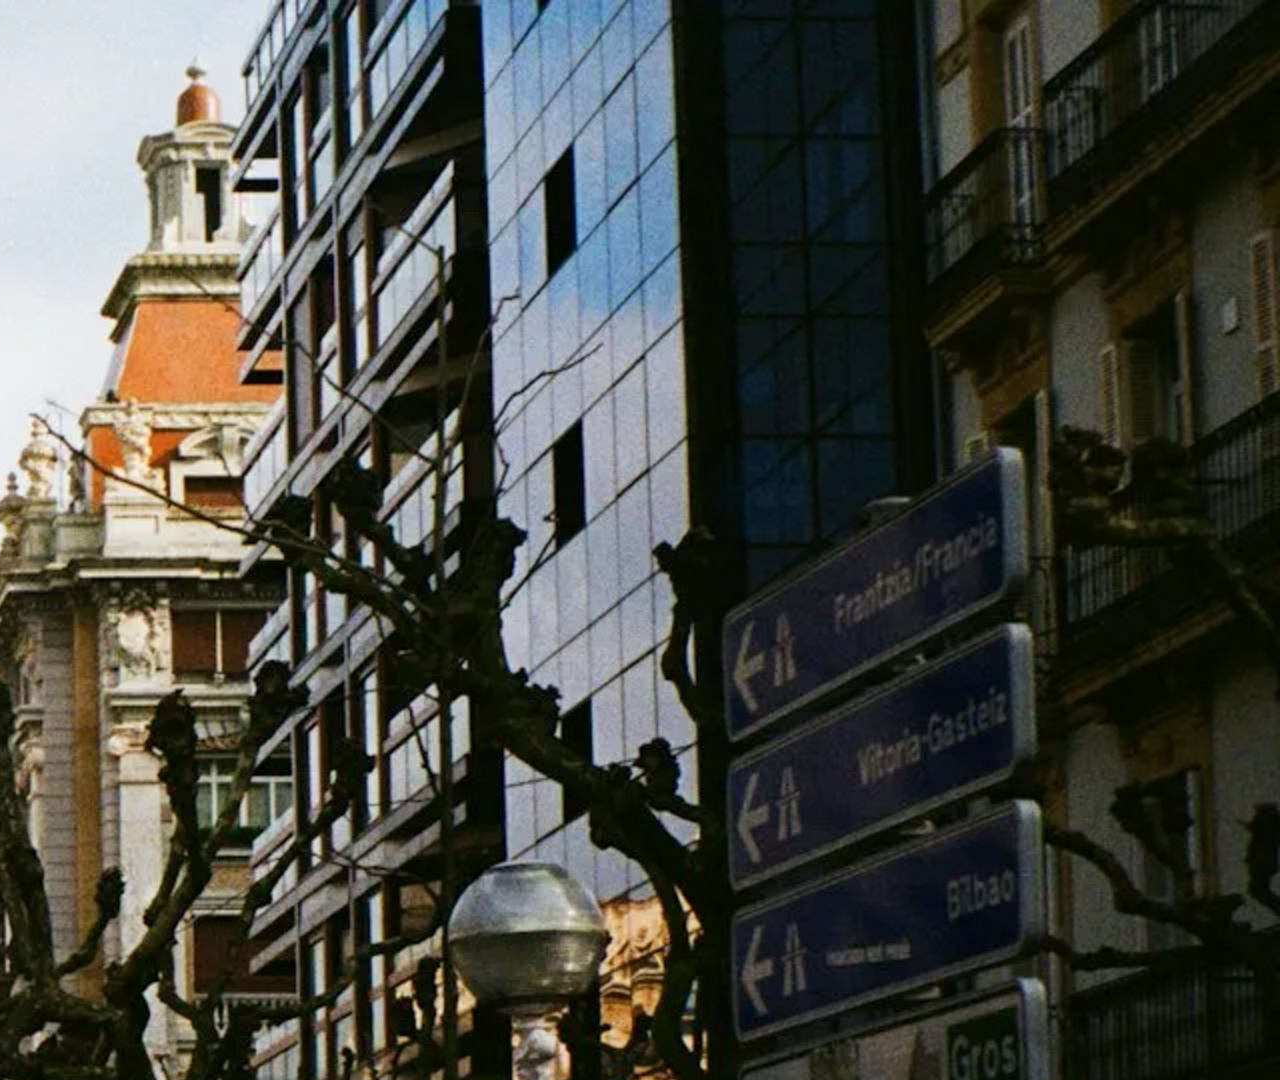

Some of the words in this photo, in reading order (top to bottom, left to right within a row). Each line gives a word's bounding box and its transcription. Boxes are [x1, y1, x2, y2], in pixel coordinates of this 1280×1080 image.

[831, 513, 1000, 635] Frantzia/Francia
[856, 690, 1009, 785] Vitoria-Gasteiz
[946, 869, 1014, 921] Bilbao
